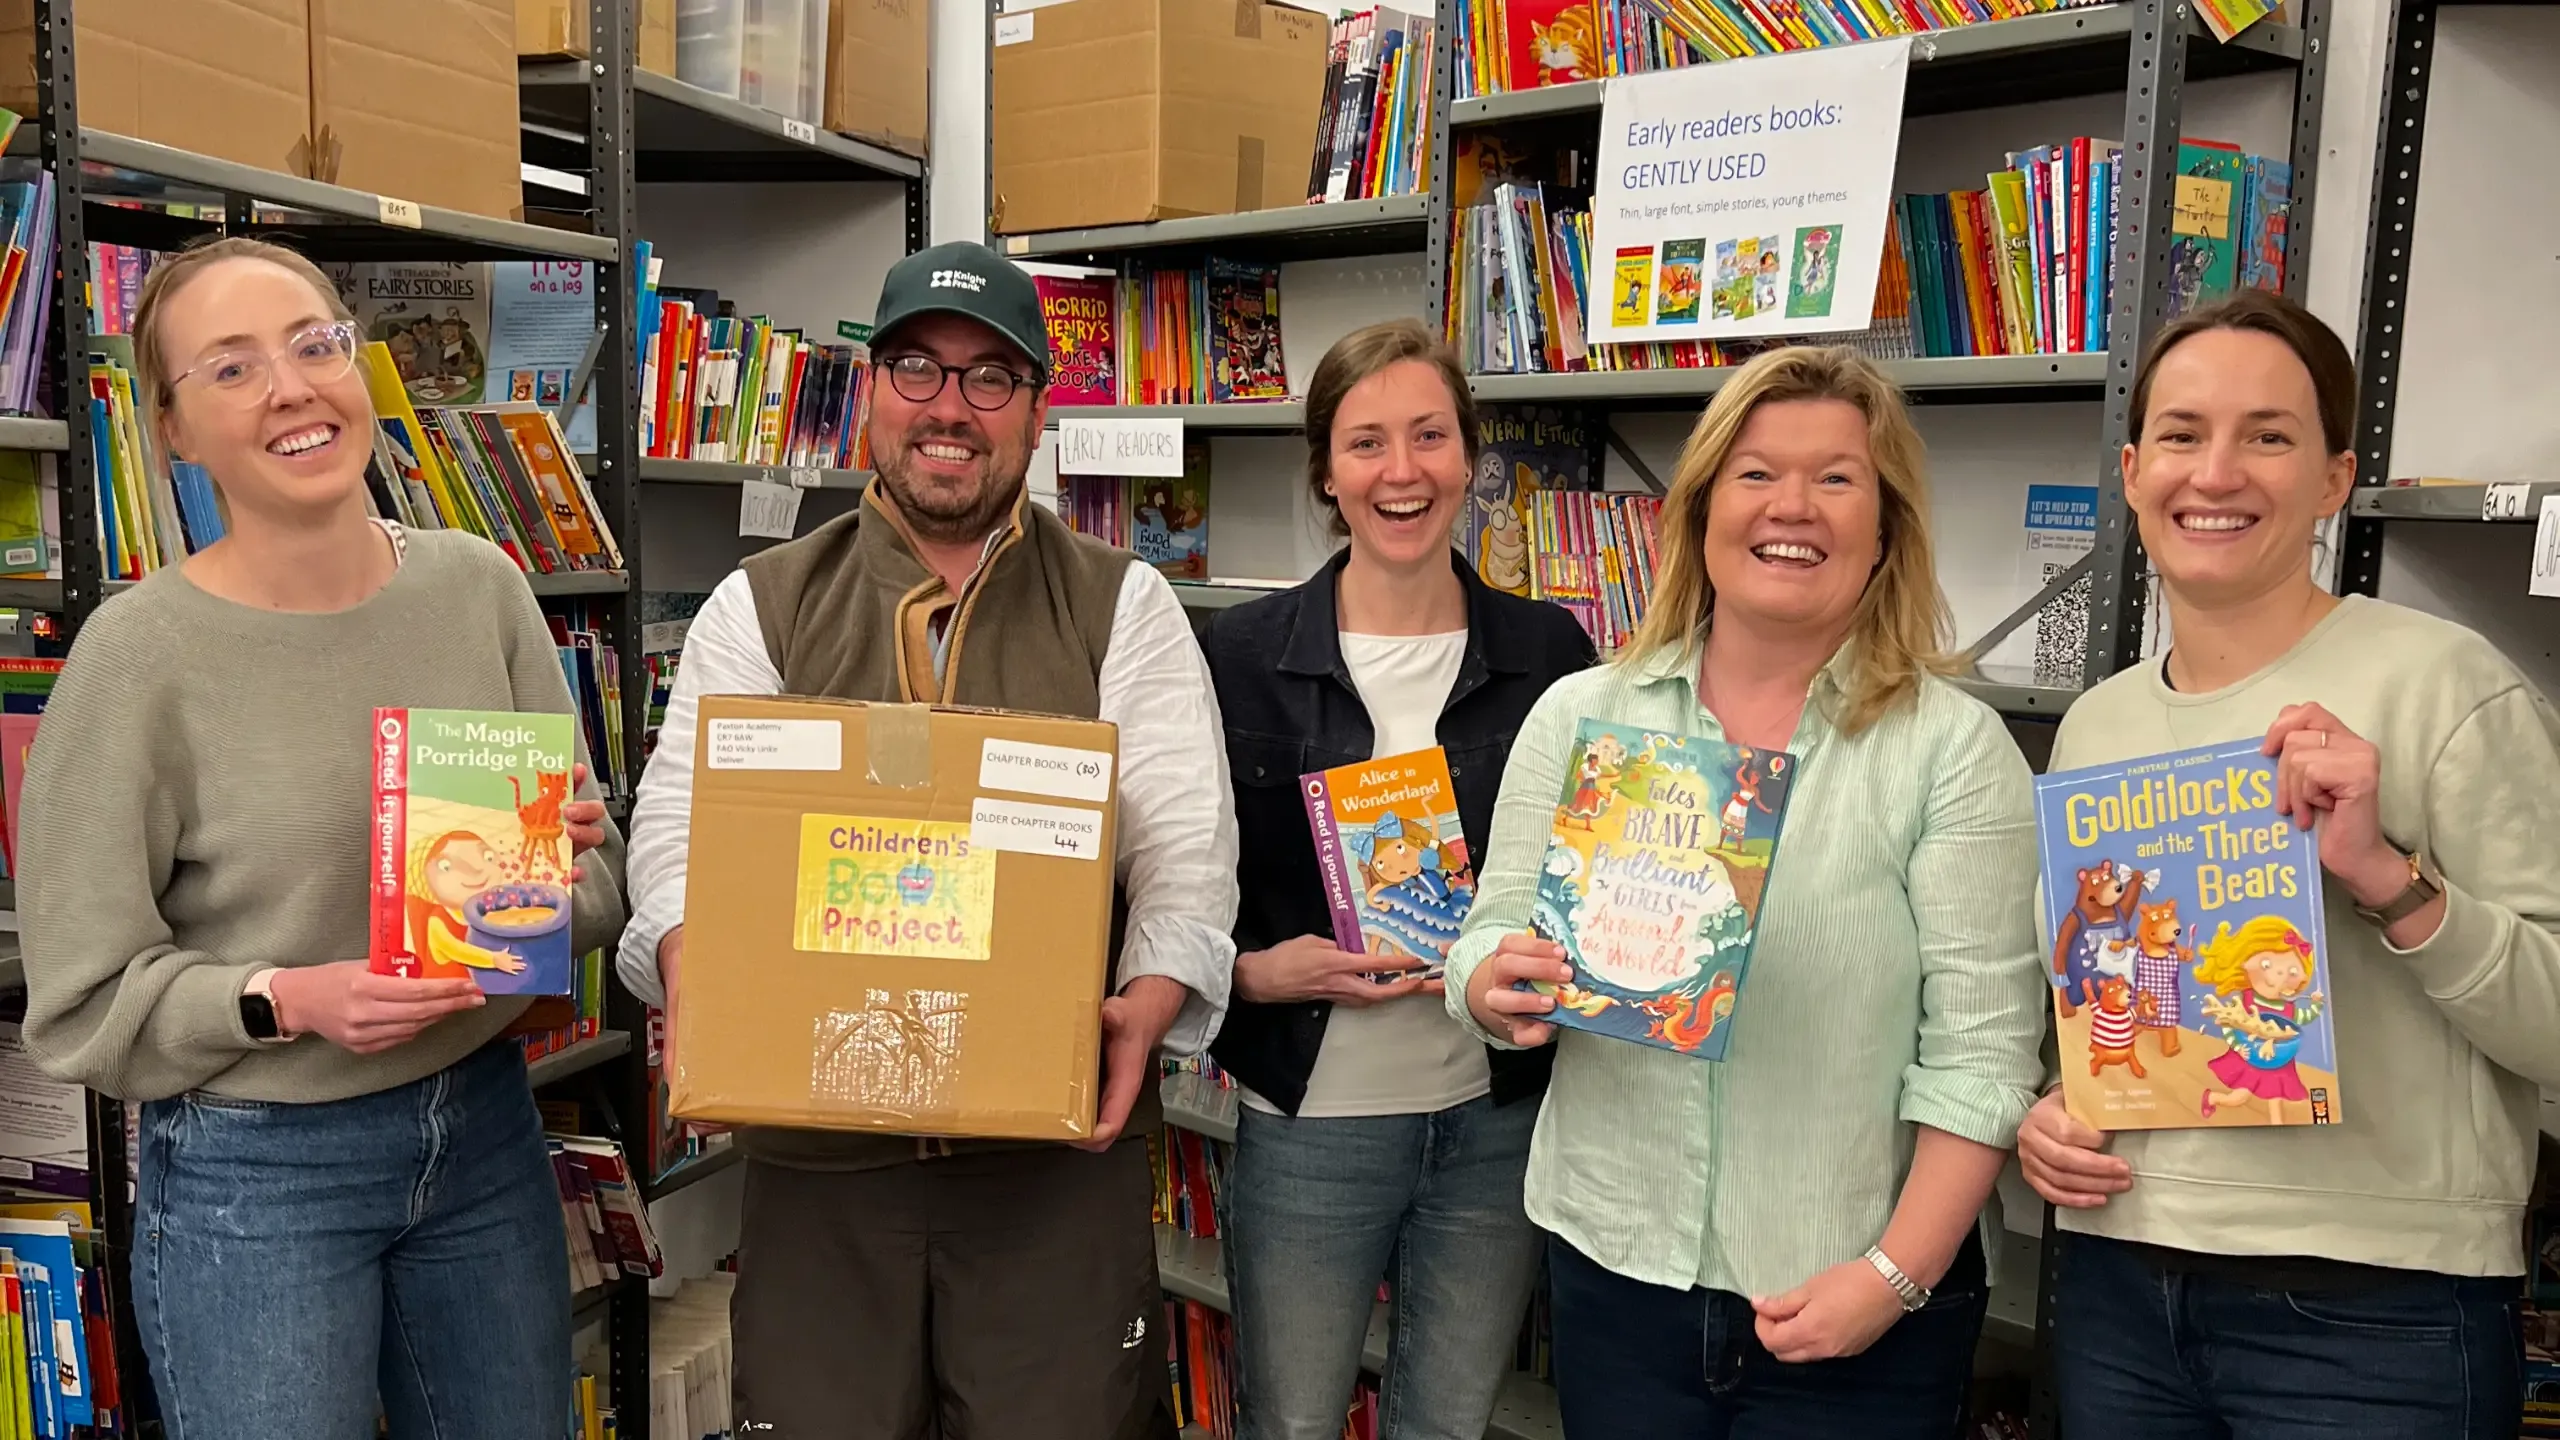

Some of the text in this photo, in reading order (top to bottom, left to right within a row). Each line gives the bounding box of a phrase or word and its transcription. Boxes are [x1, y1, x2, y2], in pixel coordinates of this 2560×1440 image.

[1627, 99, 1843, 148] Early readers books:
[1623, 152, 1767, 190] GENTLY USED
[1619, 189, 1848, 220] Thin, large font, simple stories, young themes
[368, 278, 475, 299] FAIRY STORIES
[529, 279, 583, 295] on a log
[952, 280, 981, 293] Frank
[953, 270, 987, 287] Knight
[841, 325, 862, 337] World
[1046, 317, 1111, 344] HENRY'S
[1048, 350, 1092, 367] JOKE
[1048, 367, 1096, 388] BOOK
[1064, 426, 1175, 465] EARLY READERS
[2084, 515, 2097, 527] CO
[435, 722, 536, 748] The Magic
[381, 744, 400, 791] Read
[416, 745, 567, 772] Porridge Pot
[716, 756, 745, 765] Deliver
[986, 752, 1032, 767] CHAPTER
[1034, 758, 1070, 771] BOOKS
[1359, 767, 1417, 789] Alice in
[380, 794, 398, 808] it
[1341, 778, 1441, 814] Wonderland
[1648, 778, 1696, 809] Tales
[2065, 766, 2272, 848] Goldilocks
[975, 812, 1094, 834] OLDER CHAPTER BOOKS
[1312, 800, 1333, 838] Read
[1623, 806, 1706, 850] BRAVE
[377, 809, 397, 887] yourself
[829, 826, 970, 858] Children's
[1054, 834, 1079, 852] 44
[1321, 838, 1333, 851] it
[2136, 820, 2290, 862] and the Three
[1588, 839, 1717, 896] Brilliant
[1322, 851, 1350, 912] yourself
[2197, 863, 2298, 911] Bears
[823, 907, 965, 947] Project
[391, 955, 415, 965] Level
[395, 965, 408, 978] 1
[1606, 940, 1686, 978] World
